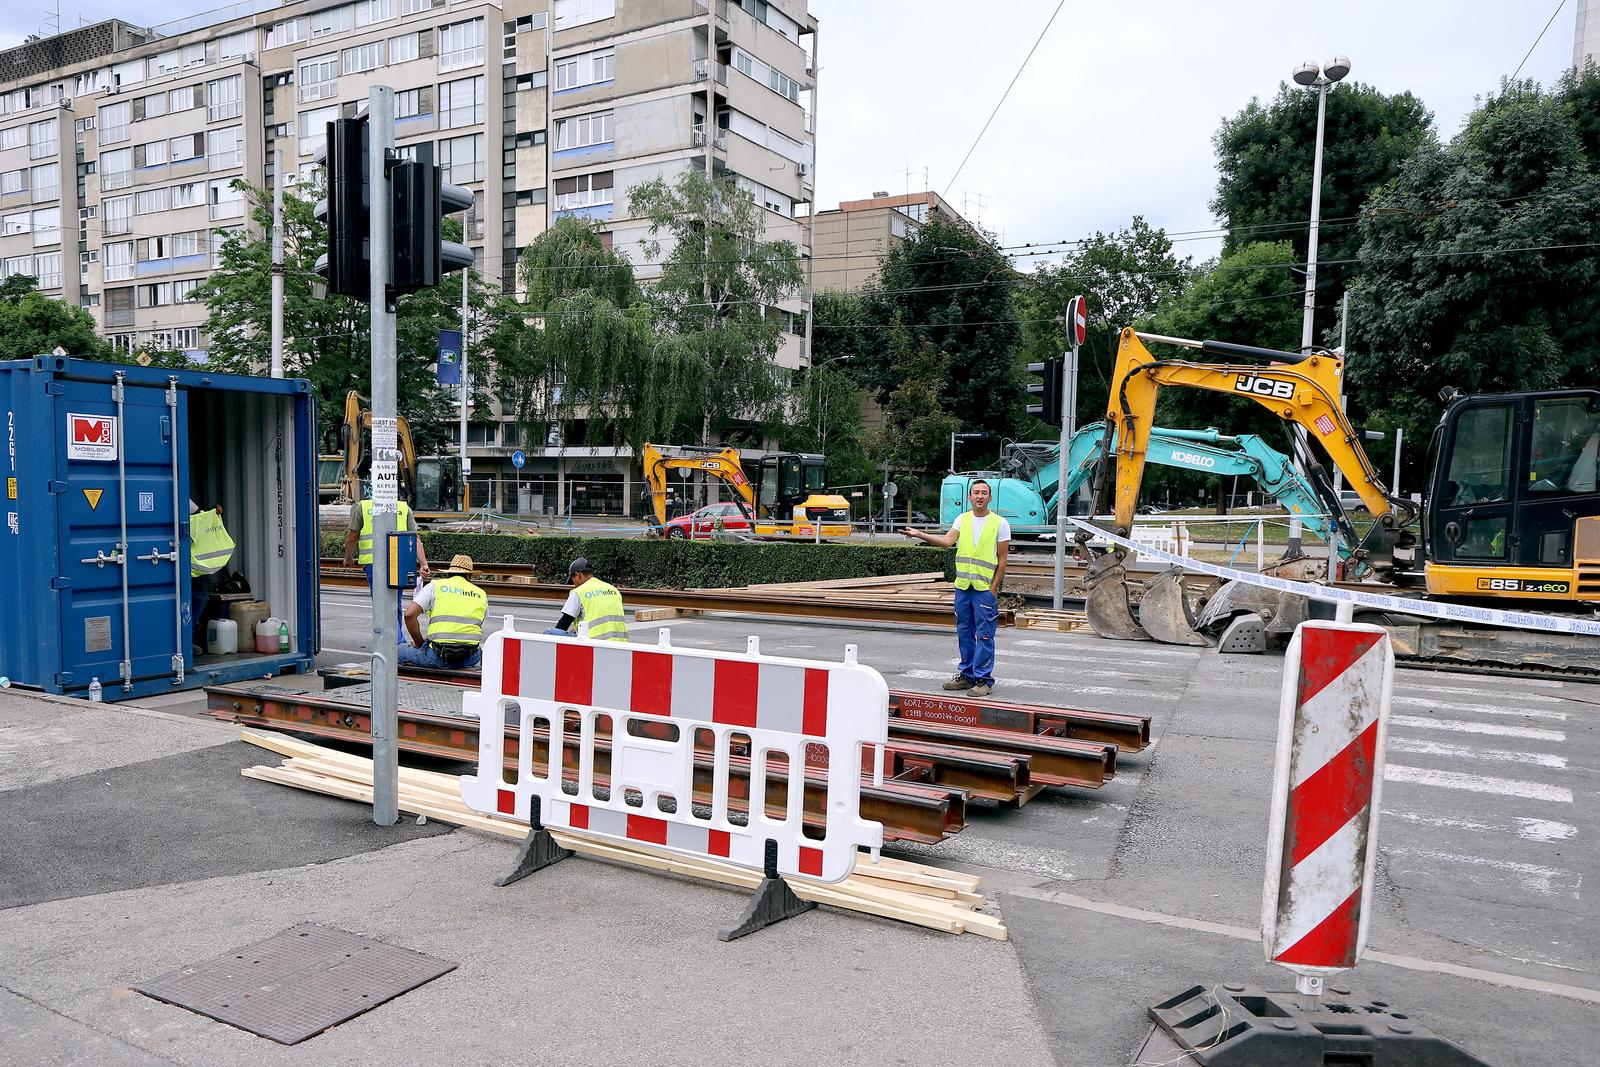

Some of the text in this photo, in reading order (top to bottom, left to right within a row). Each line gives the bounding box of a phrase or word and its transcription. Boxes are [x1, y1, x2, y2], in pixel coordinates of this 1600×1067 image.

[1236, 376, 1294, 398] JCB
[101, 422, 110, 443] BOX
[701, 461, 720, 469] JCB
[1171, 450, 1215, 468] KOBELCO
[1490, 579, 1519, 592] 85
